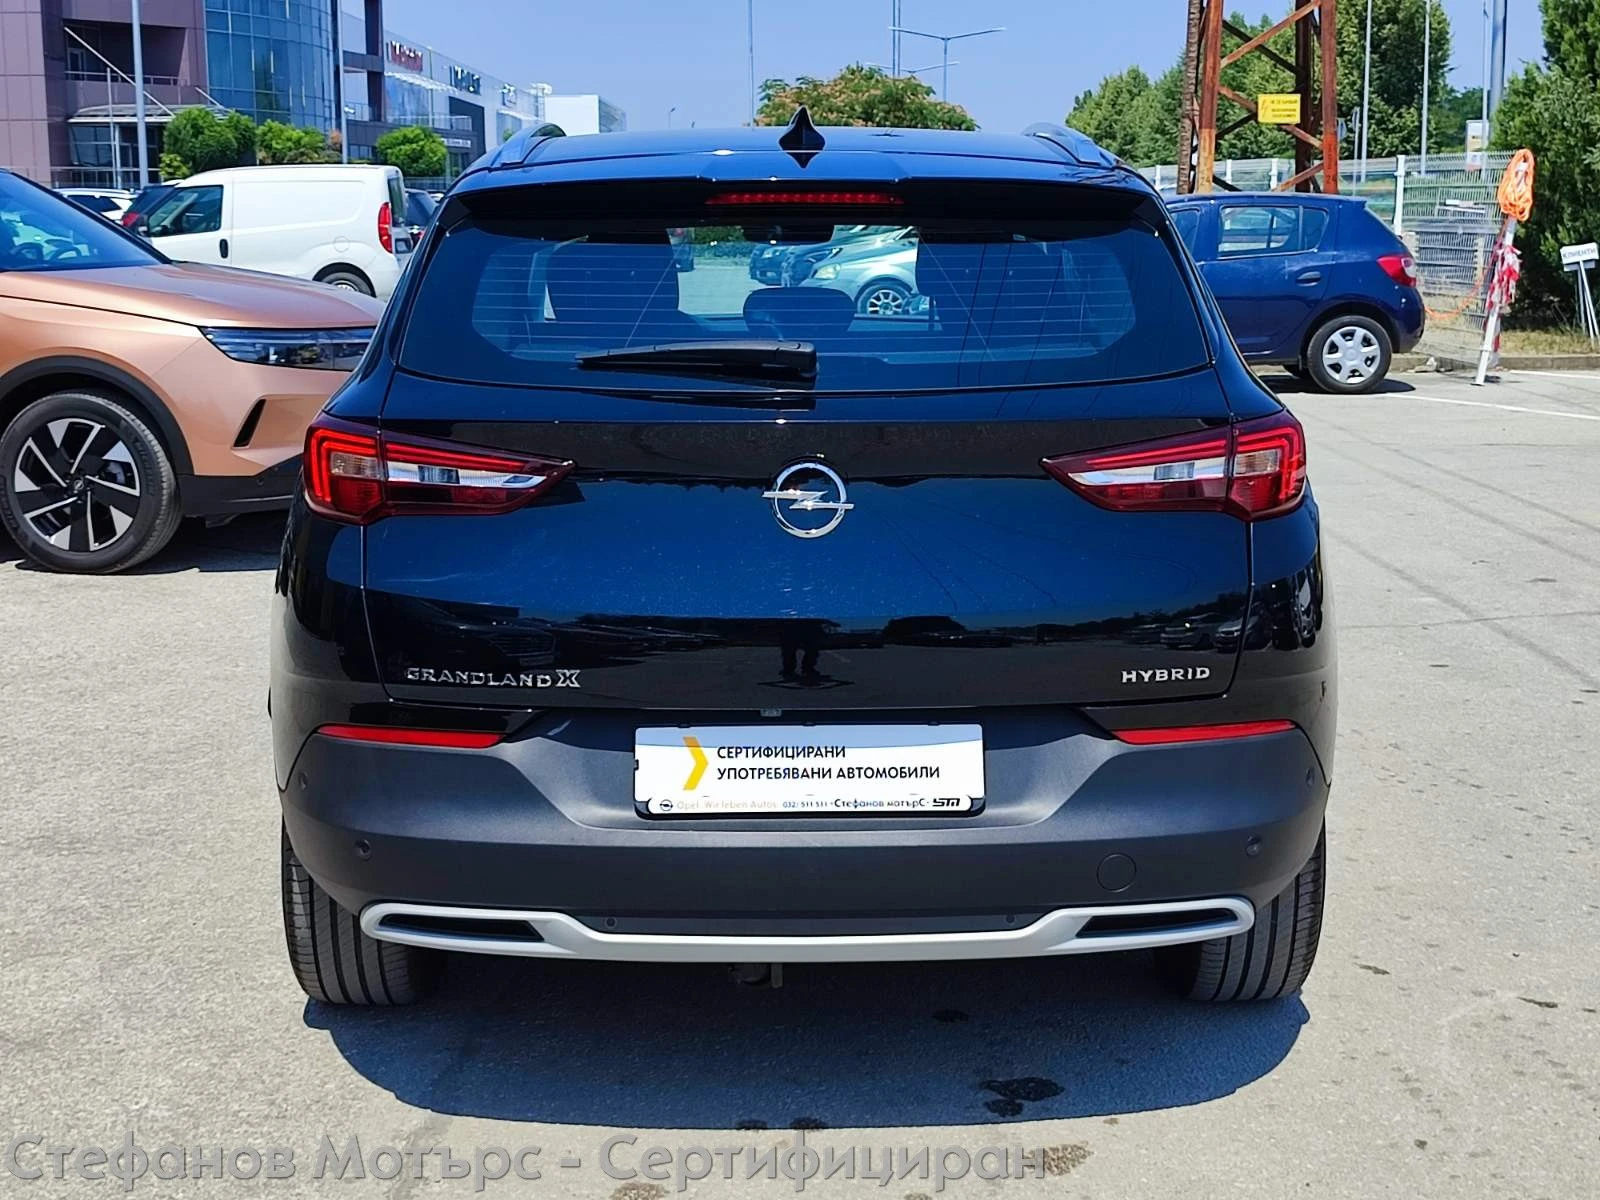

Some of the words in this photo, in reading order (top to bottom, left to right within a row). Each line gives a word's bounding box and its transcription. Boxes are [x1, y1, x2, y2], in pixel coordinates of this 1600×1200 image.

[406, 667, 552, 688] GRANDLAND
[555, 669, 581, 688] X
[1121, 667, 1211, 683] HYBRID
[717, 746, 846, 760] СЕРТИФИЦИРАНИ
[717, 767, 833, 780] УПОТРЕБЯВАНИ
[836, 766, 940, 779] АВТОМОБИЛИ
